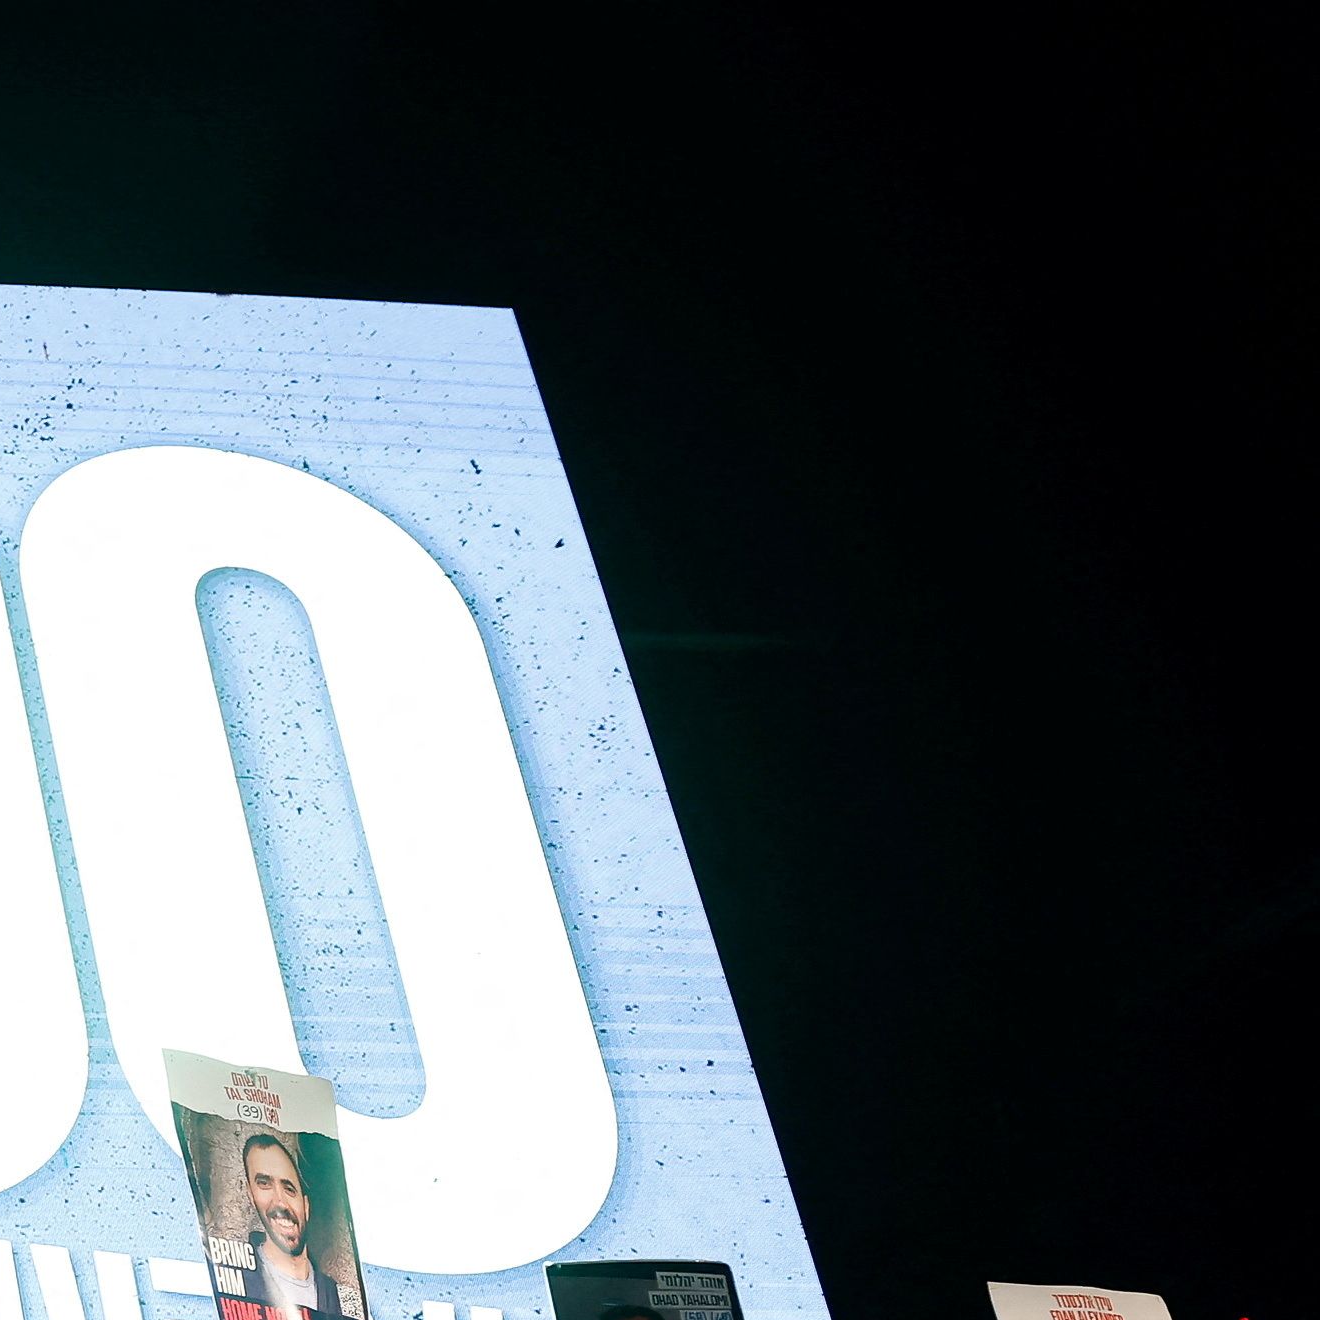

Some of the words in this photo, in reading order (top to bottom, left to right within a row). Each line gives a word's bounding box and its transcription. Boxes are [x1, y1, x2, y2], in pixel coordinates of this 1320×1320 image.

[224, 1086, 243, 1099] TAL
[245, 1088, 281, 1109] SHOHAM
[237, 1104, 262, 1122] (39)
[209, 1237, 257, 1271] BRING
[214, 1267, 246, 1297] HIM
[661, 1274, 695, 1288] יהלומי
[701, 1277, 725, 1289] אוהד
[652, 1294, 679, 1306] OHAD
[680, 1294, 729, 1307] YAHALOMI
